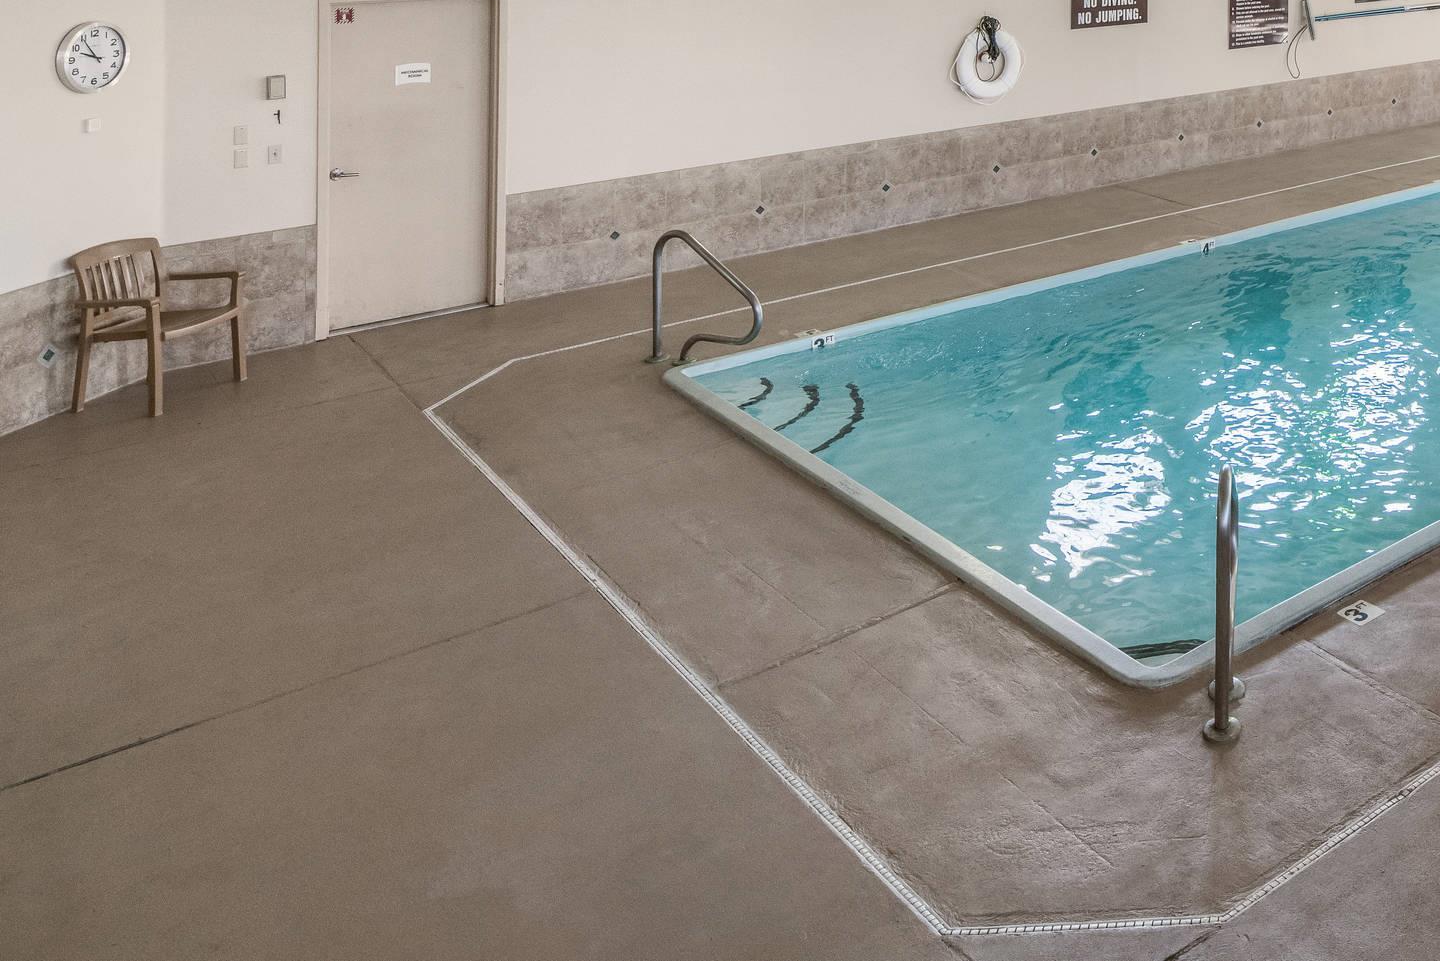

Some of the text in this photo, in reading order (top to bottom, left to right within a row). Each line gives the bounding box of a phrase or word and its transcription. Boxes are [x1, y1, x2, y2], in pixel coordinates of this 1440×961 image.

[1077, 8, 1142, 25] NO JUMPING.
[91, 29, 99, 38] 12
[81, 34, 87, 42] 11
[110, 38, 117, 46] 2
[72, 44, 80, 52] 10
[113, 50, 120, 58] 3
[72, 68, 79, 76] 8
[90, 77, 97, 85] 6
[825, 335, 834, 343] FT
[1344, 602, 1368, 622] 3 FT
